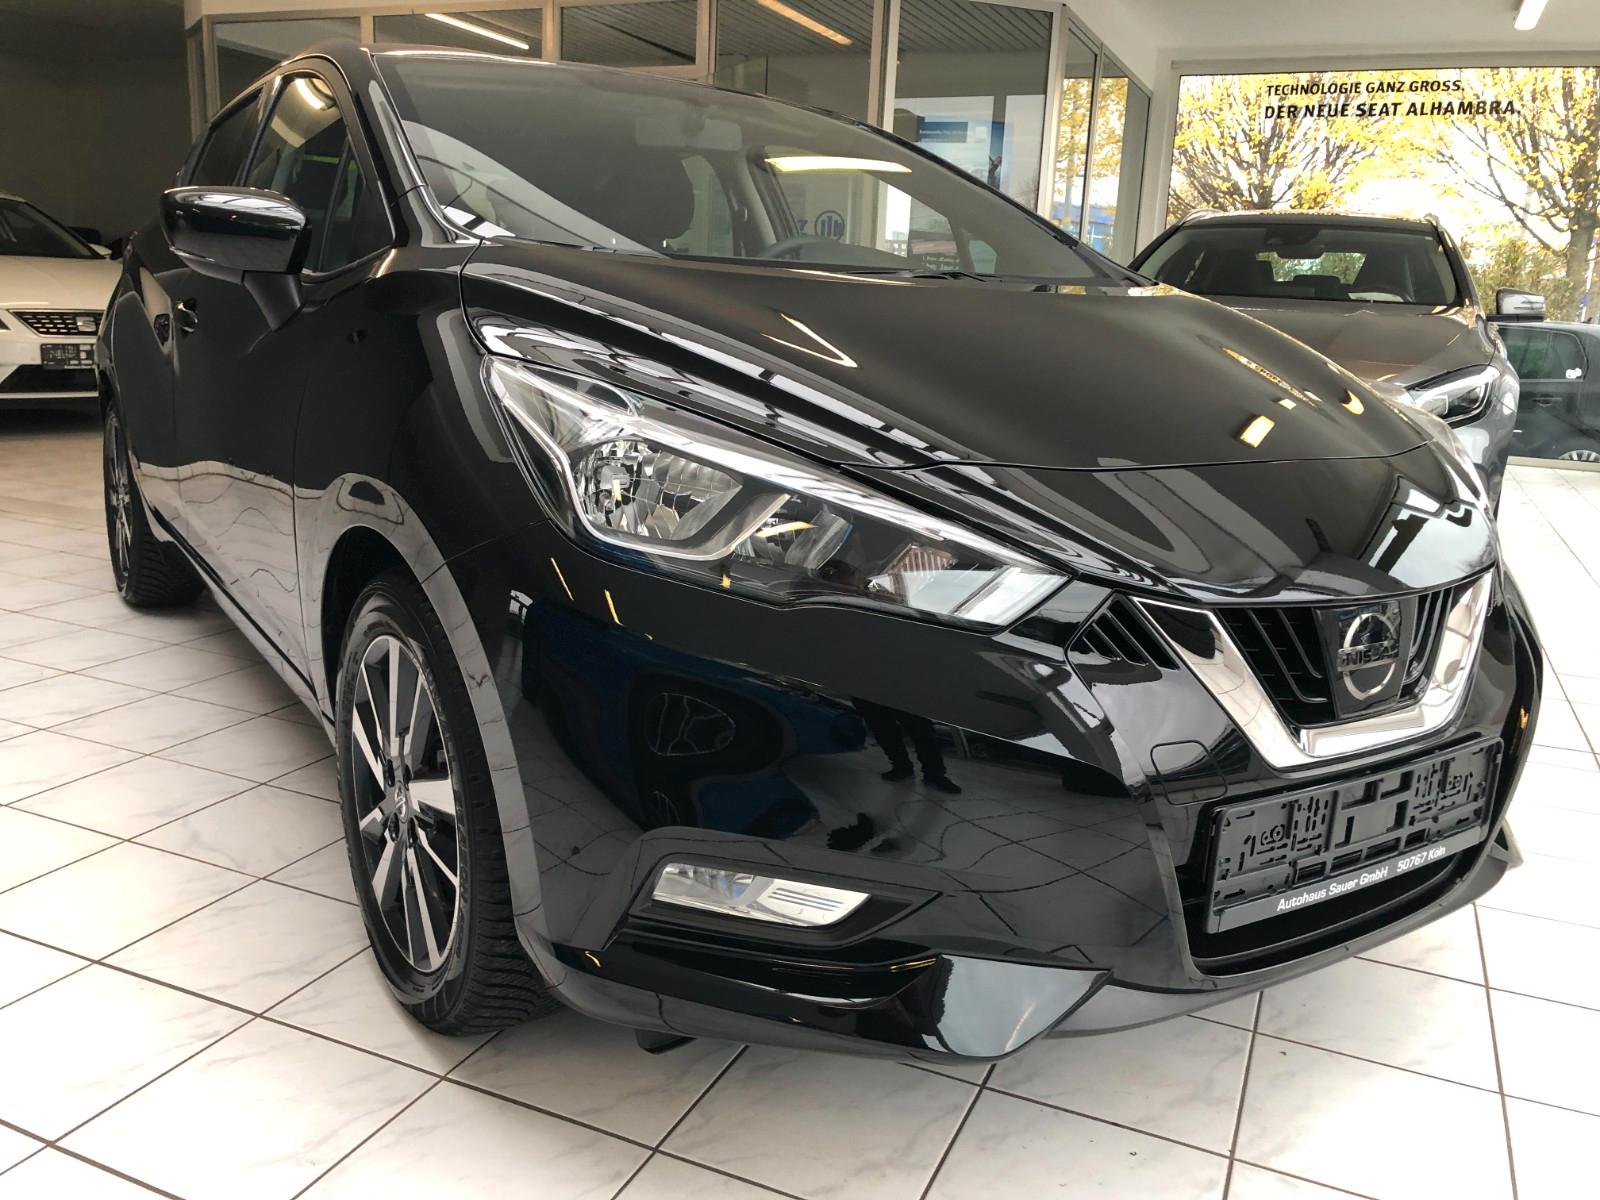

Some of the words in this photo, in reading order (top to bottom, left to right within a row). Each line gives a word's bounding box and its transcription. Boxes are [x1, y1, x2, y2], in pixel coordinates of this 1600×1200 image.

[1267, 82, 1361, 96] TECHNOLOGIE
[1365, 81, 1405, 94] GANZ
[1409, 79, 1465, 92] GROSS.
[1264, 105, 1299, 119] DER
[1303, 103, 1349, 118] NEUE
[1355, 102, 1402, 117] SEAT
[1406, 100, 1521, 116] ALHAMBRA.
[1276, 890, 1327, 911] Autohaus
[1328, 880, 1358, 895] Sauer
[1359, 866, 1388, 885] GmbH
[1396, 852, 1428, 872] 50767
